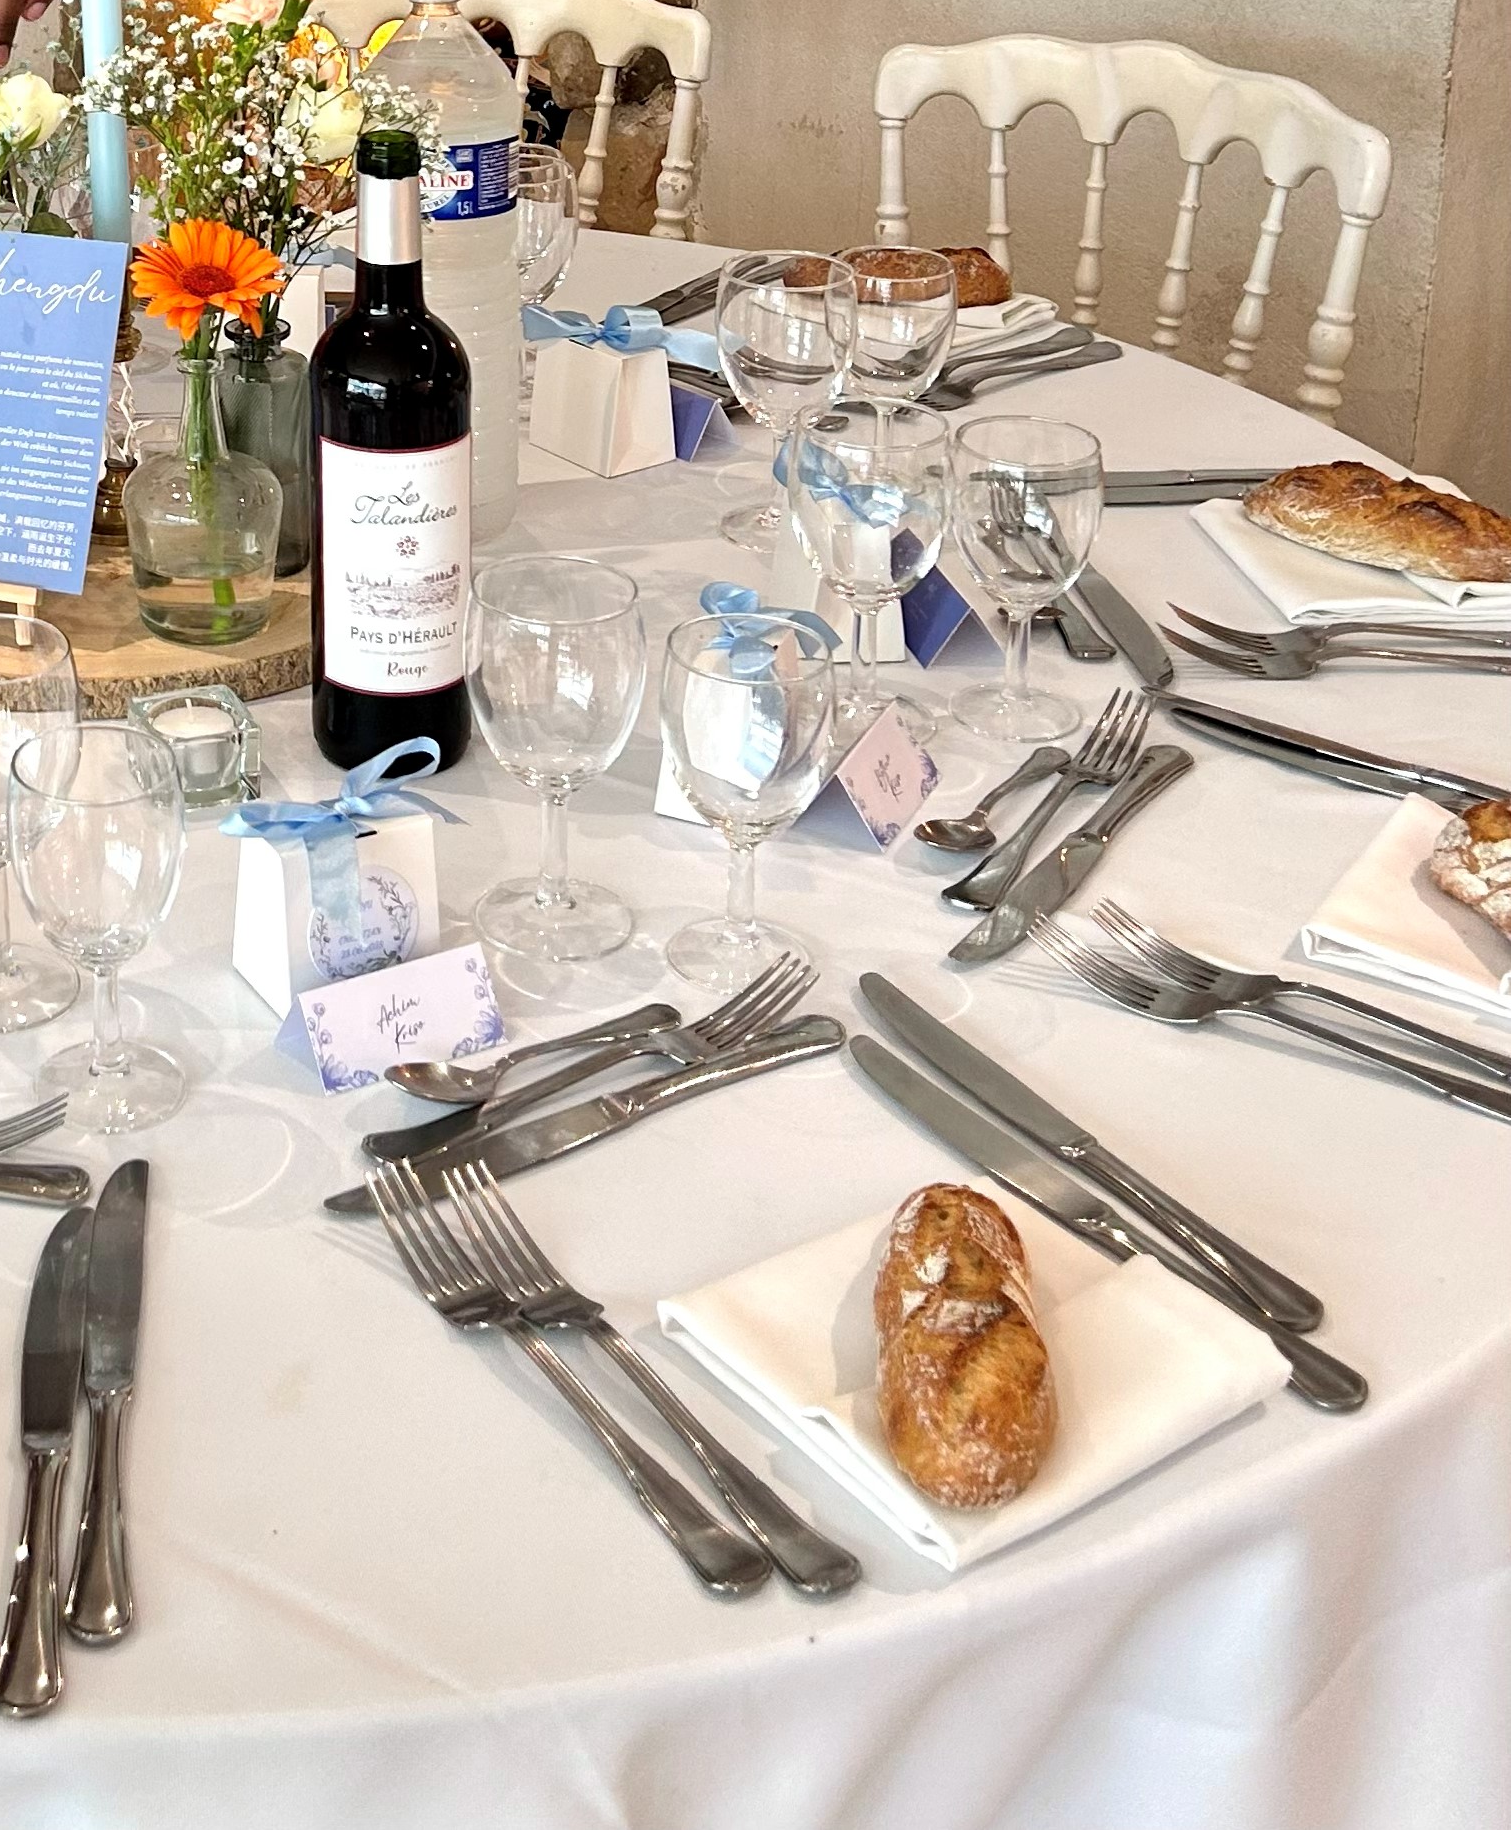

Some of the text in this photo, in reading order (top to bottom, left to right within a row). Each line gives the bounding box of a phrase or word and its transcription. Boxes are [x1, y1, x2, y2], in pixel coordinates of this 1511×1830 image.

[419, 174, 470, 187] ALINE
[388, 481, 420, 506] Les
[350, 495, 457, 525] Talandières
[351, 621, 457, 644] PAYS D'HÉRAULT
[387, 662, 429, 678] Rouge
